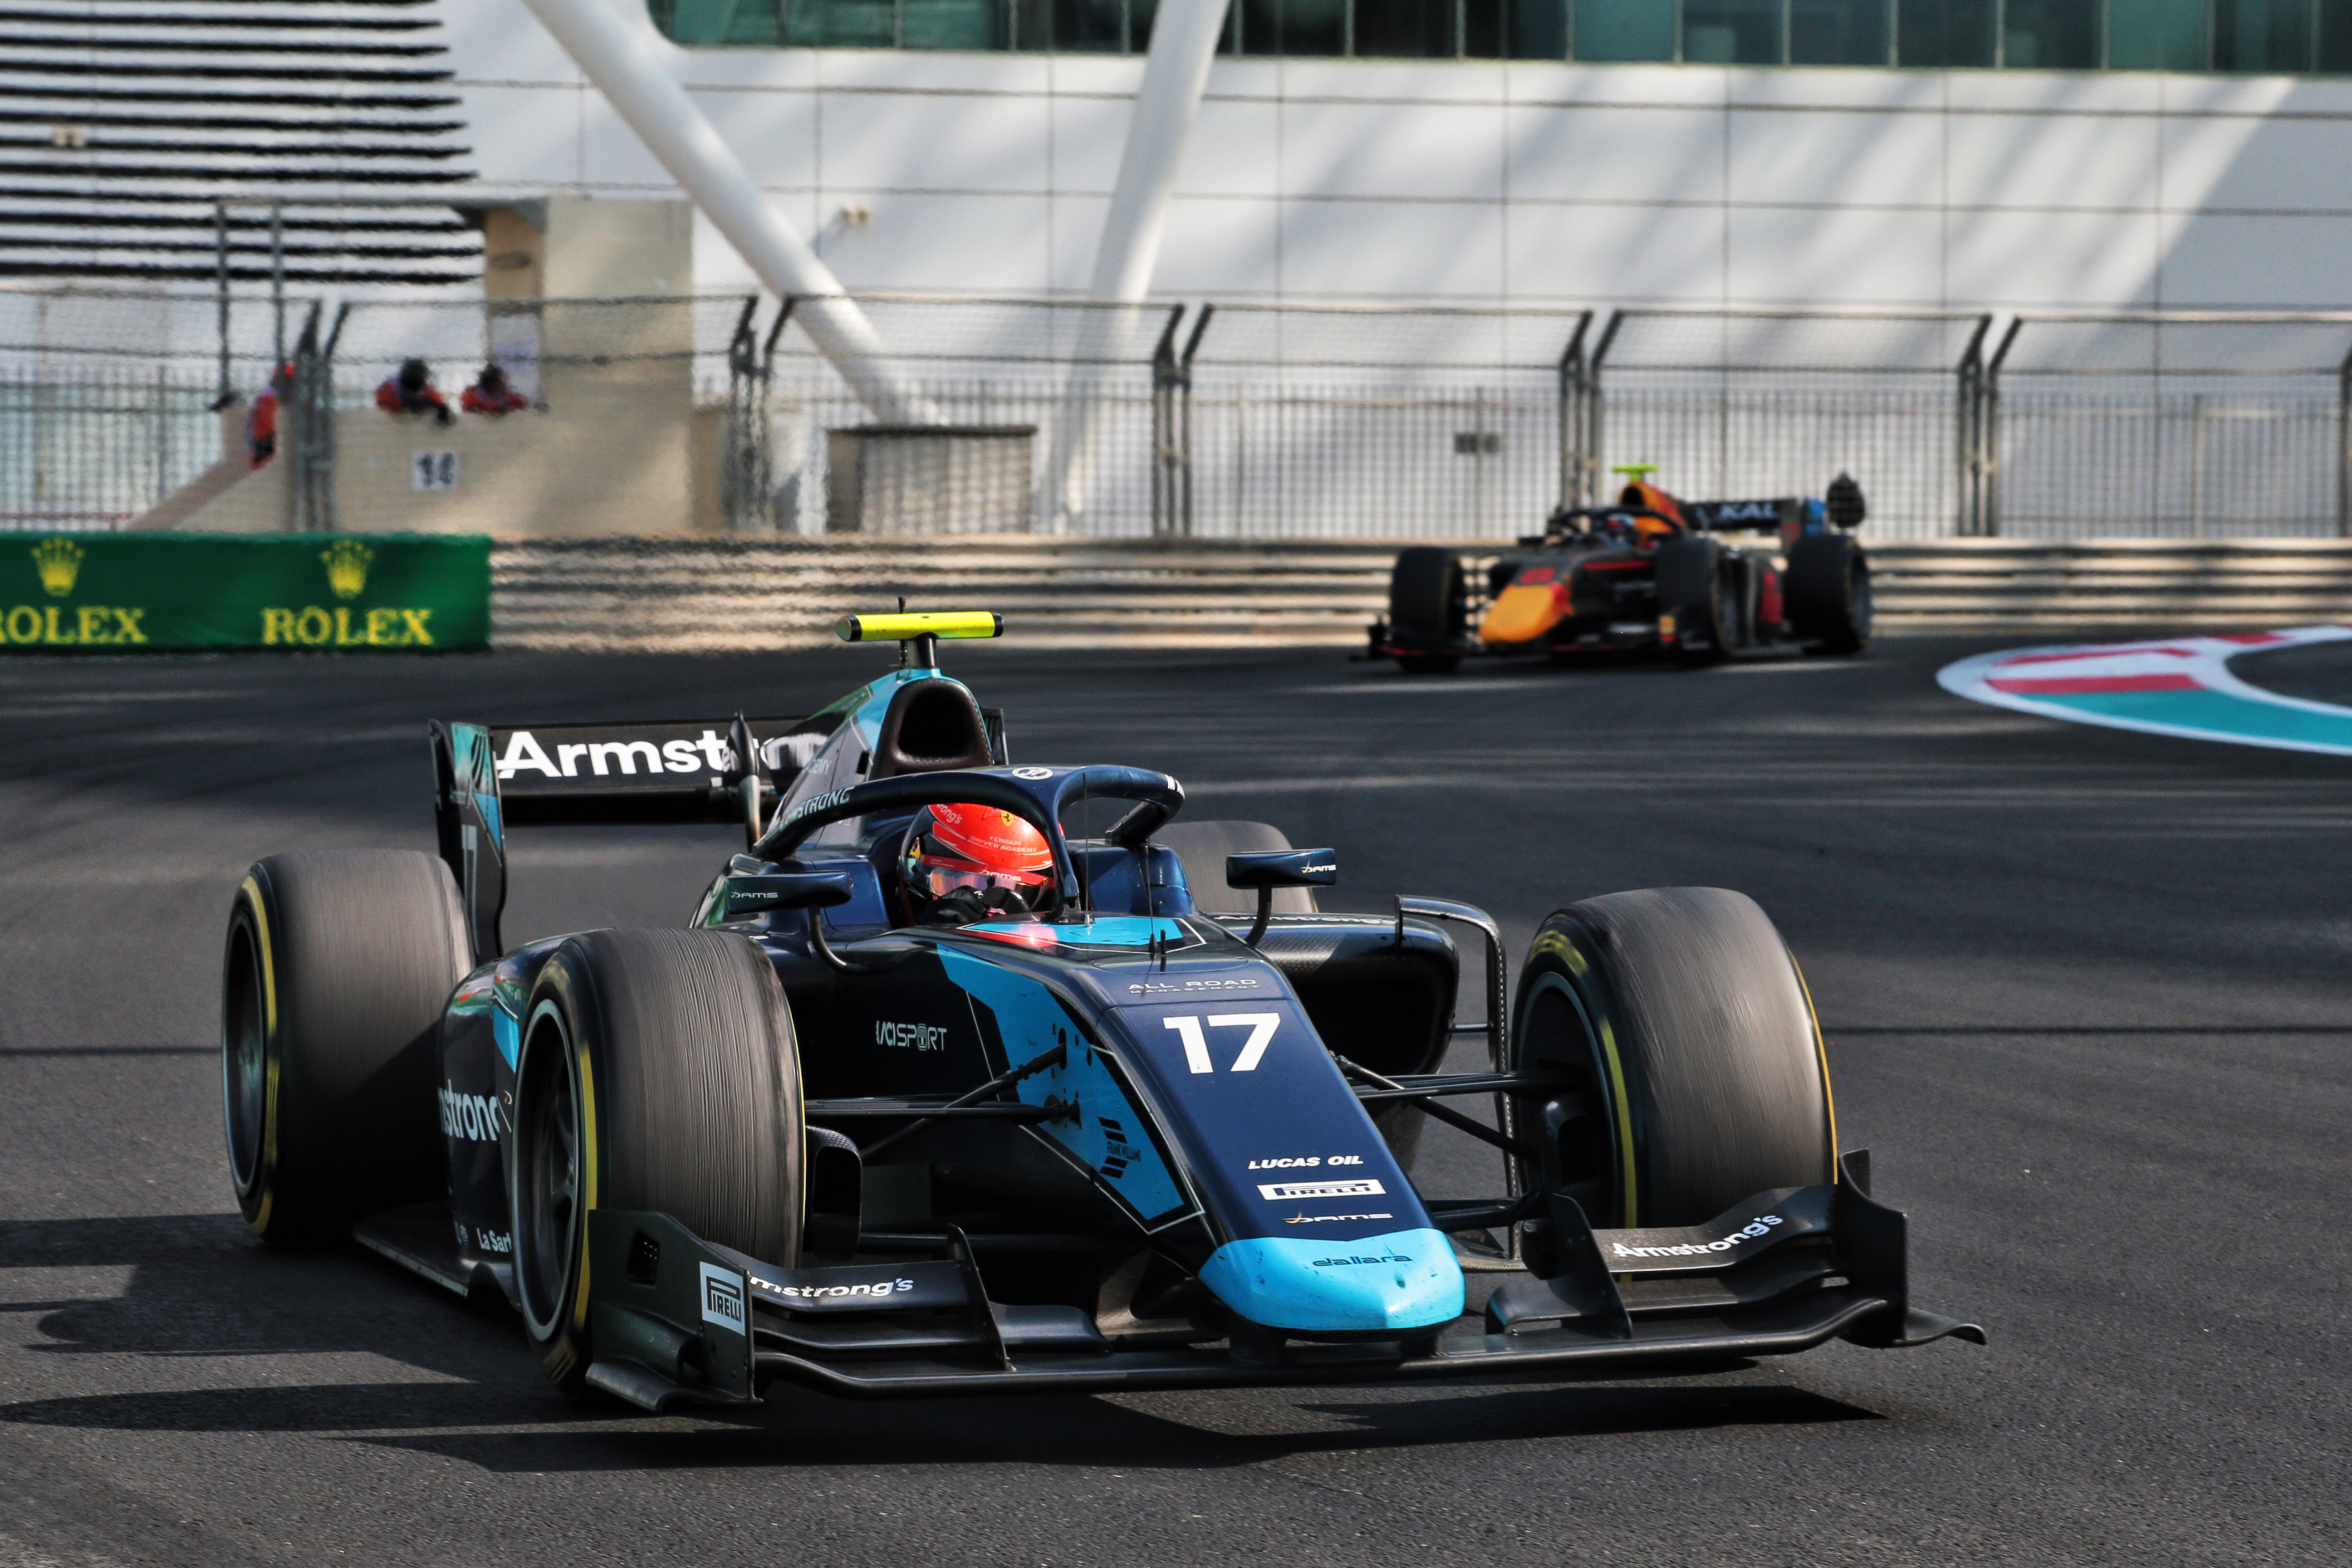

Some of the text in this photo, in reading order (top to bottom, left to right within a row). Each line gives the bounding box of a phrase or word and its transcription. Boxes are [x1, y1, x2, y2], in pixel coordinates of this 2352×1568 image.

[260, 605, 435, 645] ROLEX
[495, 730, 774, 779] Armst
[970, 836, 999, 848] DRIVER
[990, 836, 1022, 846] FERRARI
[1300, 862, 1337, 873] DAMS
[1130, 985, 1259, 994] MANAGEMENT
[1162, 1012, 1281, 1074] 17
[1248, 1155, 1364, 1170] LUCAS OIL
[1273, 1183, 1371, 1196] PIRELLI
[1281, 1213, 1393, 1224] DAMS
[476, 1228, 491, 1250] La
[1612, 1215, 1784, 1257] Armstrong's
[1313, 1255, 1413, 1266] dallara
[706, 1275, 742, 1323] PIRELLI
